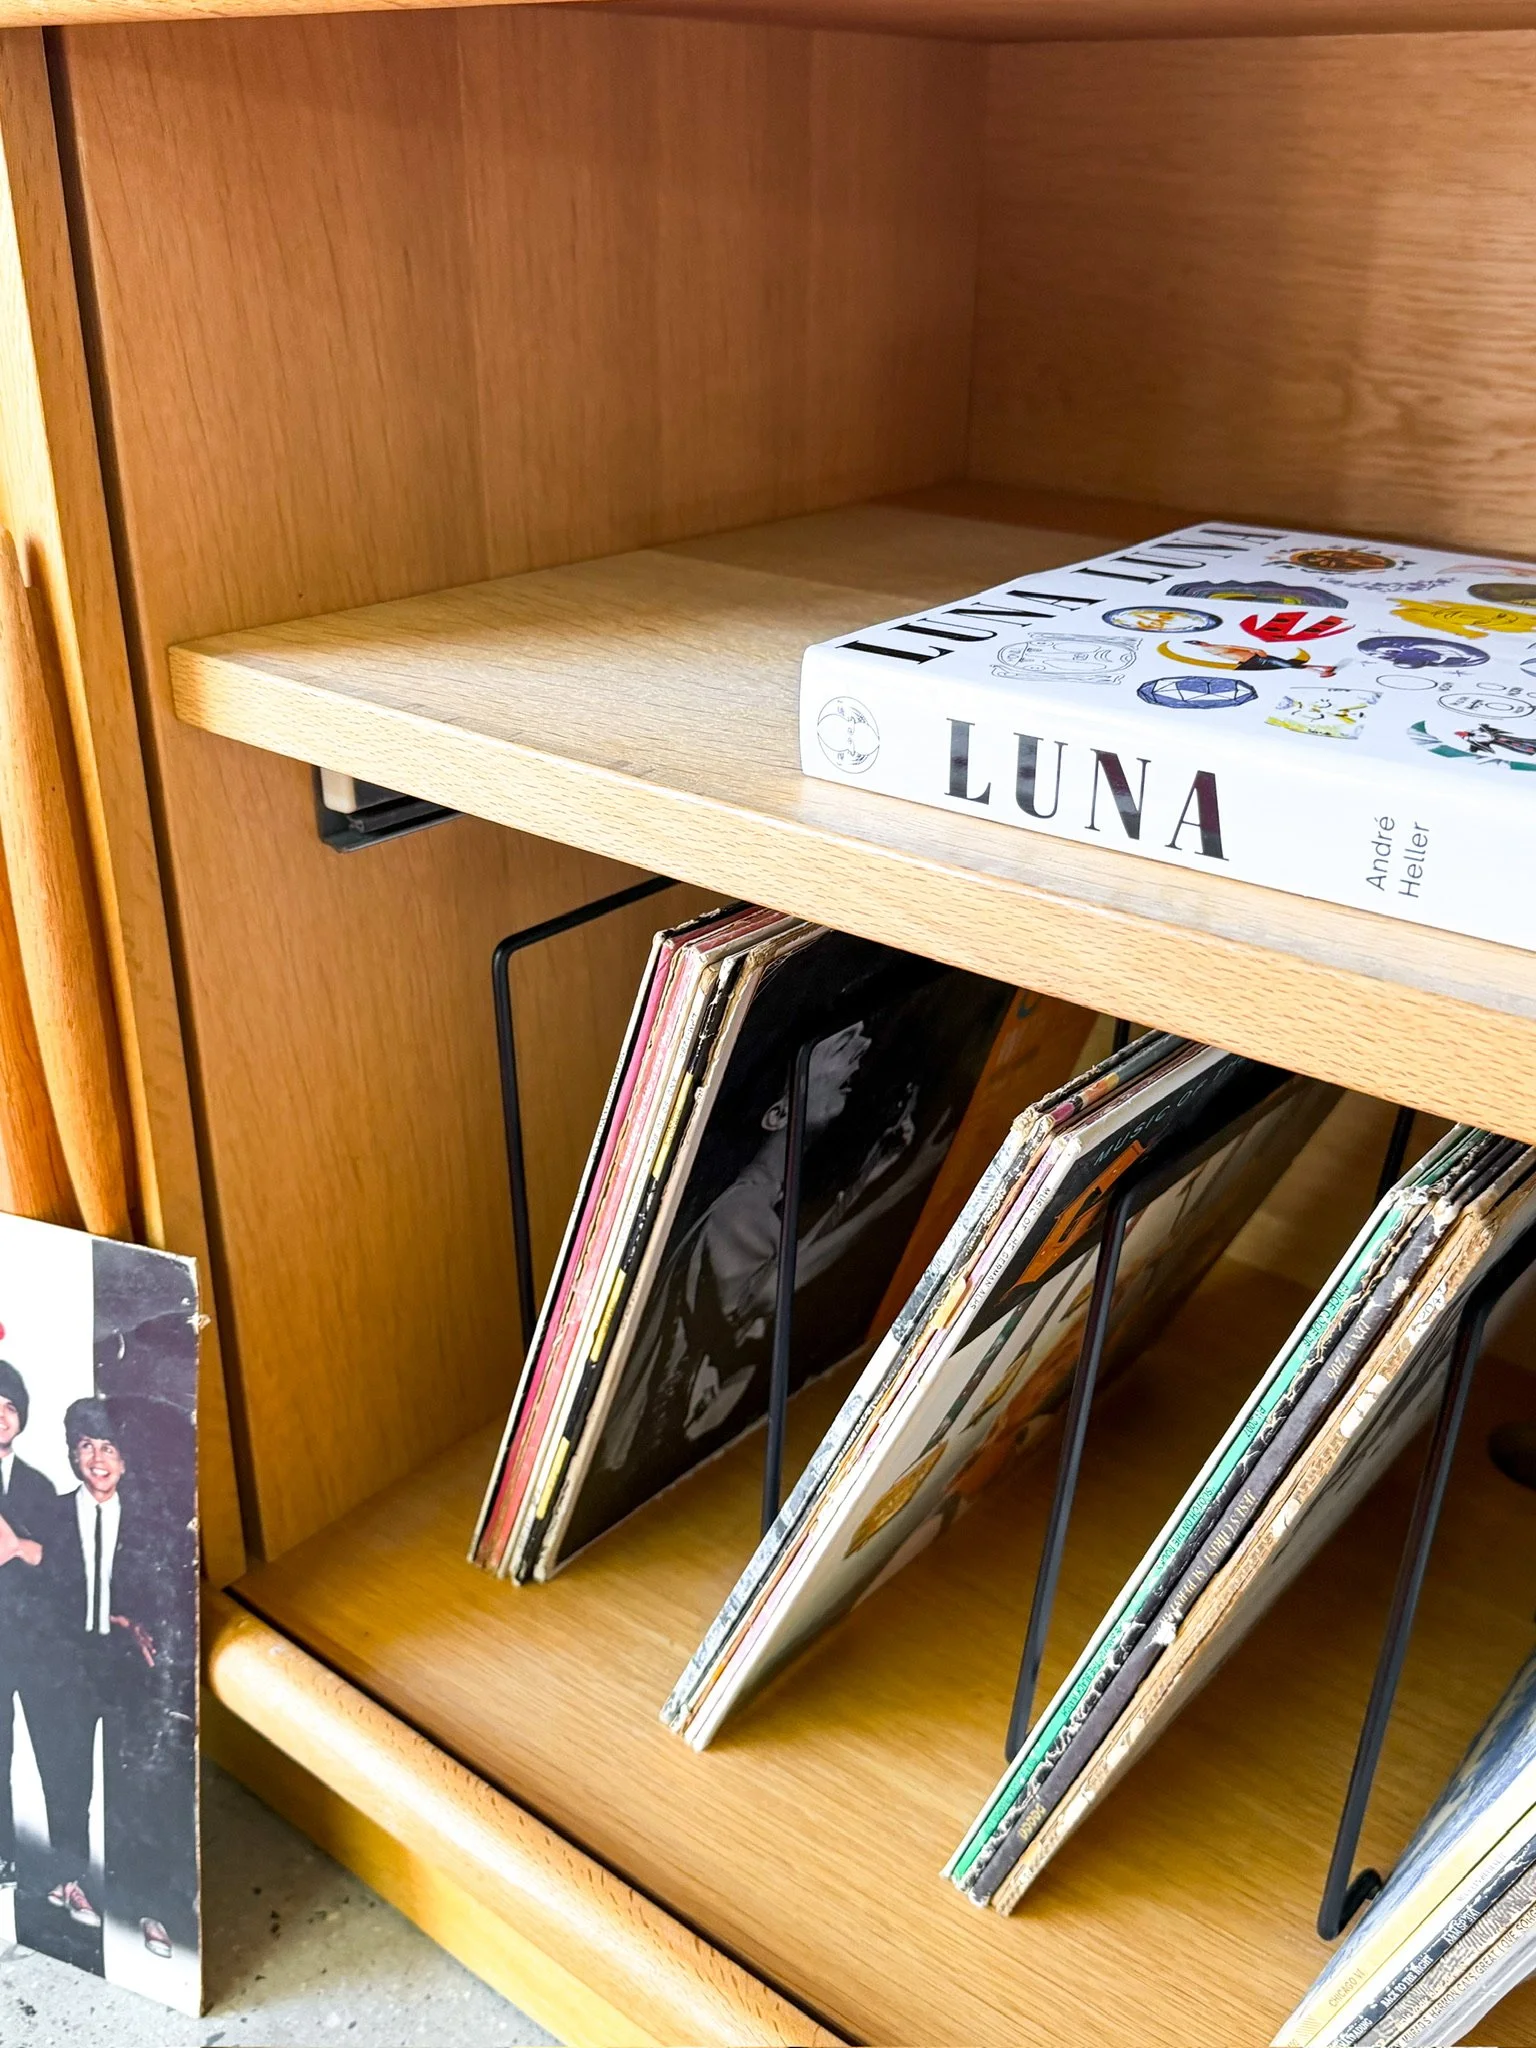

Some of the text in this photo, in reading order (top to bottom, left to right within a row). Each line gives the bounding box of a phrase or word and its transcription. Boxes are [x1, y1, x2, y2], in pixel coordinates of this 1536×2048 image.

[834, 525, 1287, 666] LUNA LUNA
[943, 716, 1230, 862] LUNA
[1364, 814, 1396, 892] André
[1397, 821, 1430, 899] Heller
[1089, 1100, 1173, 1168] MUSIC
[1172, 1076, 1211, 1109] OF
[967, 1184, 1052, 1311] MUSIC OF HE GERMAN ALPS
[1320, 1347, 1352, 1382] 7206
[1179, 1516, 1194, 1532] ON
[1226, 1487, 1261, 1527] JESUS
[1170, 1529, 1186, 1547] THE
[1200, 1521, 1239, 1567] CHRIST
[1326, 1974, 1358, 2009] CHICAGO
[1392, 1979, 1408, 1995] TO
[1399, 1969, 1418, 1987] THE
[1378, 1986, 1400, 2009] BACK
[1400, 2014, 1432, 2045] MURADS
